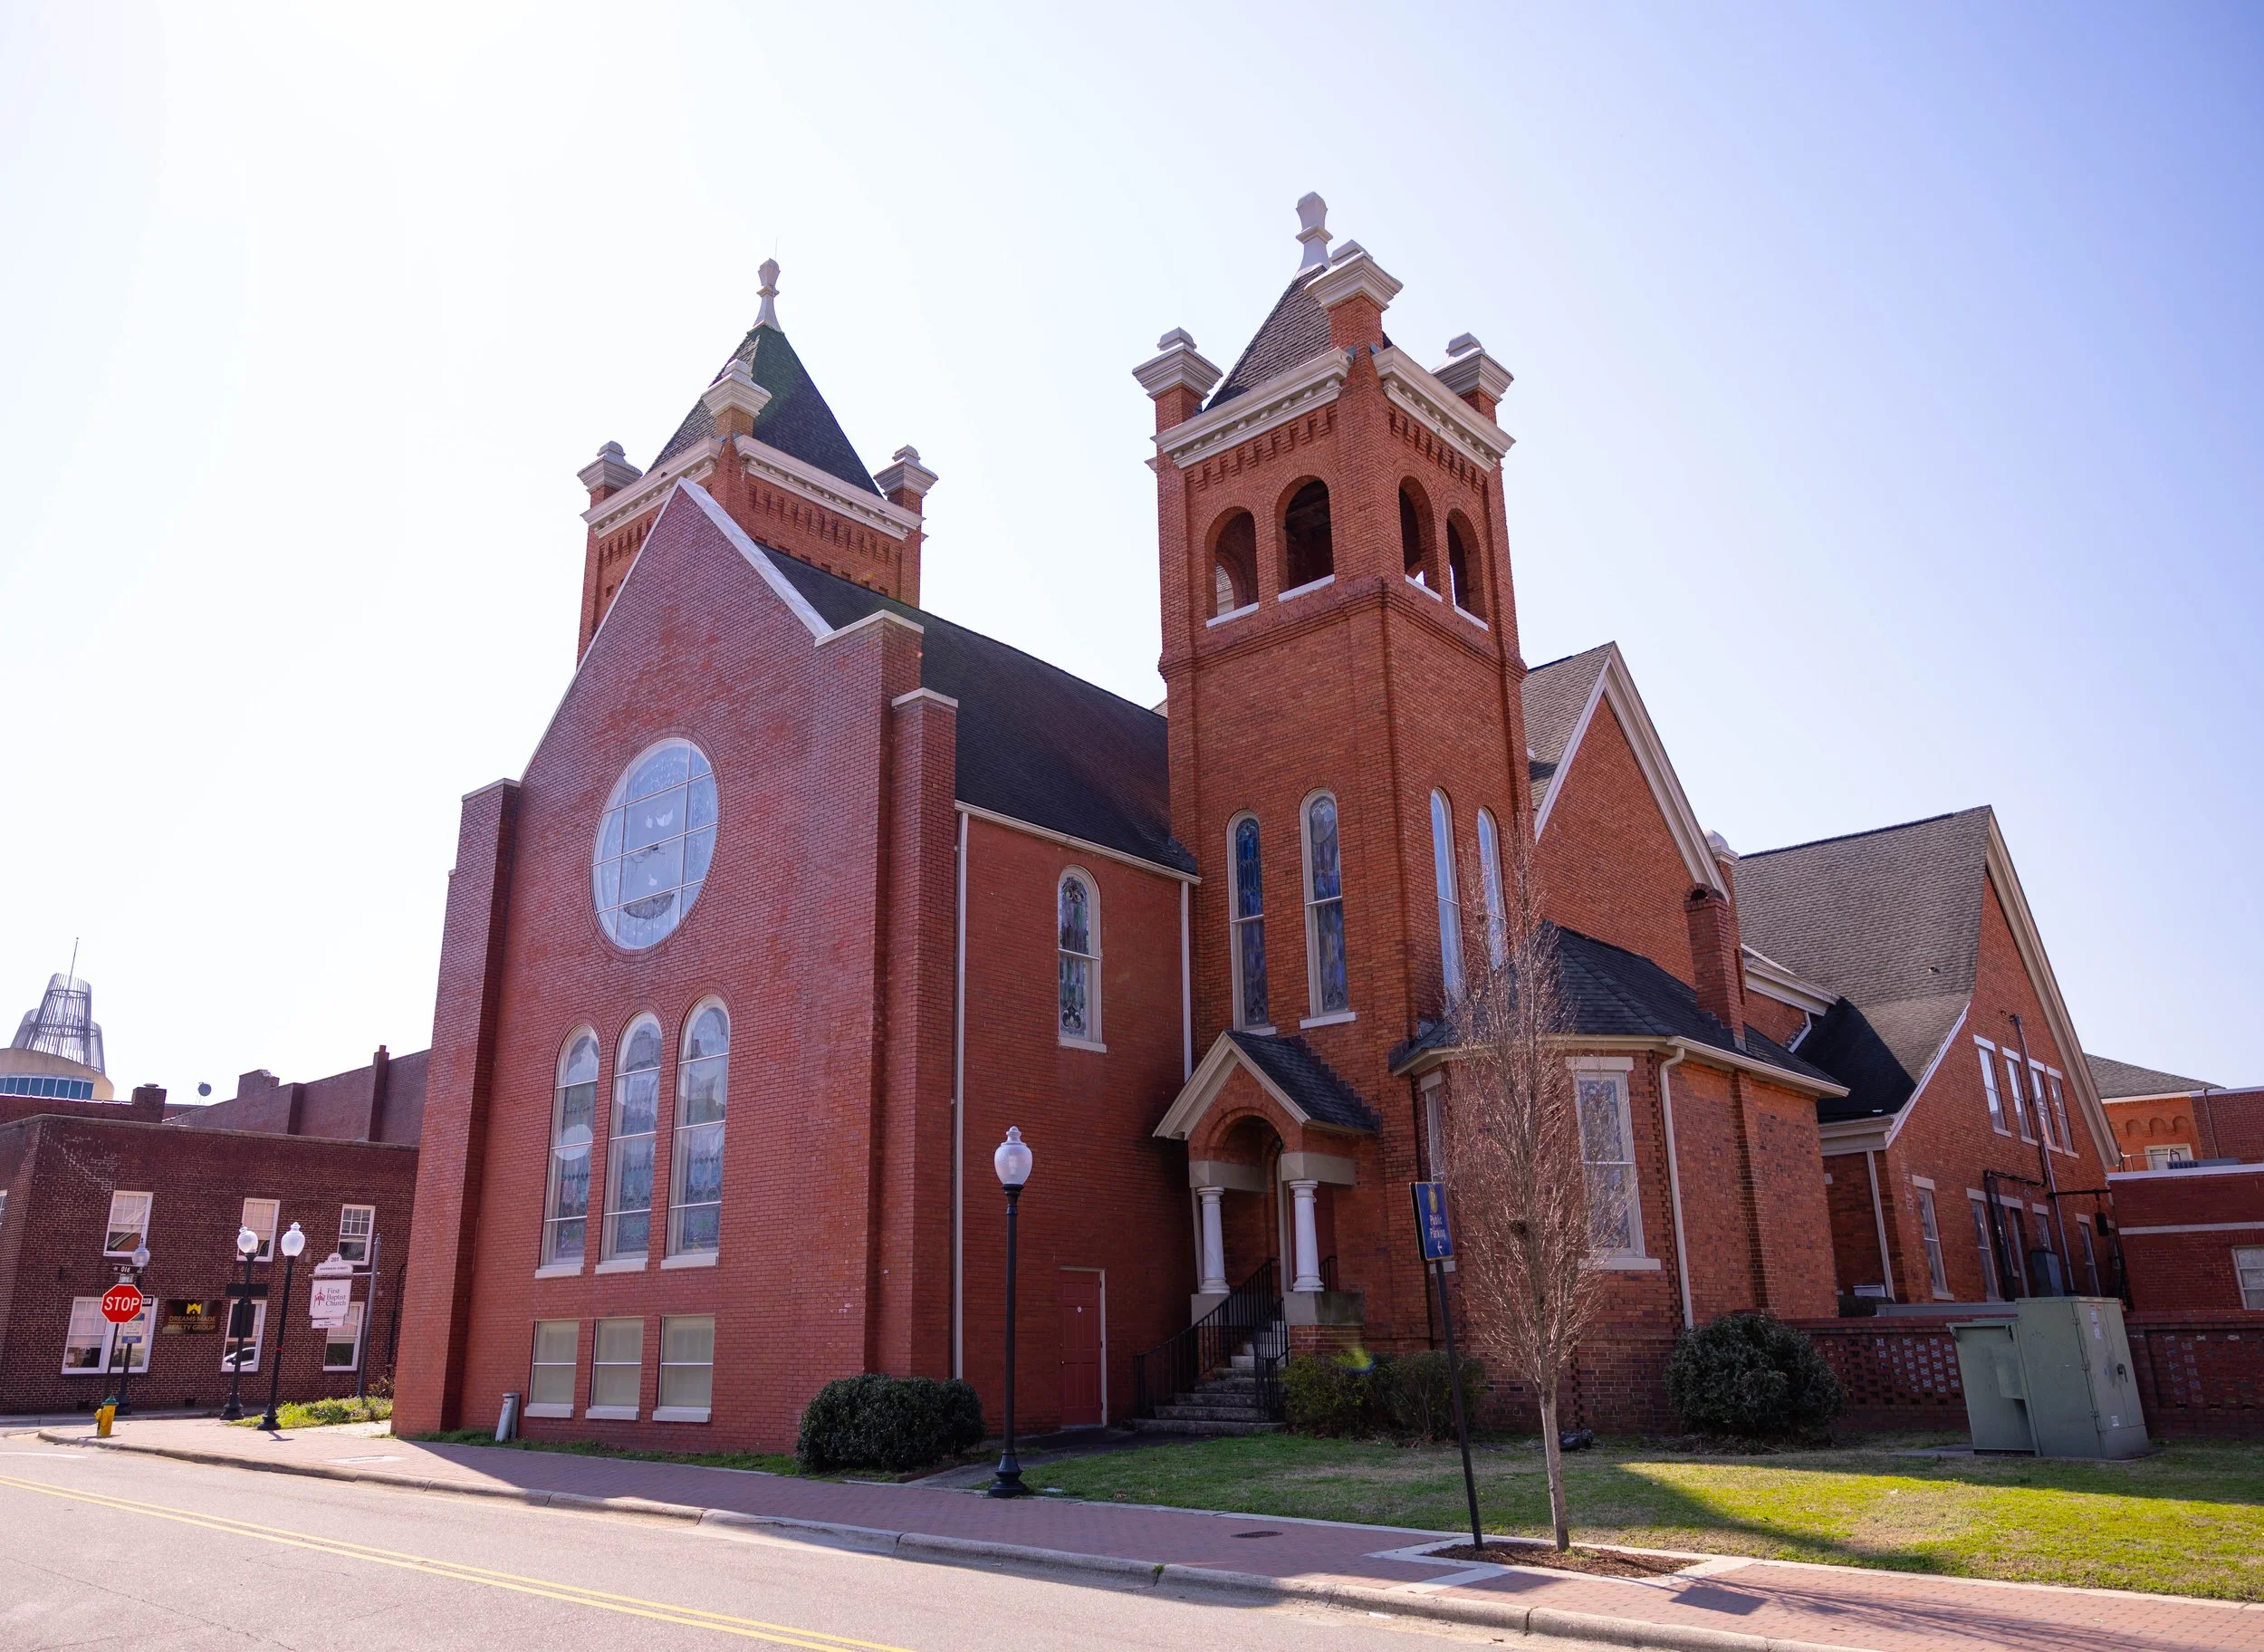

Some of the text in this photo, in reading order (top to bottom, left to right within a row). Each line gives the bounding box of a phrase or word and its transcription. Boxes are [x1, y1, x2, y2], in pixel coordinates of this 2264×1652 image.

[1429, 1215, 1443, 1225] Public
[1429, 1227, 1446, 1240] Parking
[104, 1296, 139, 1311] STOP
